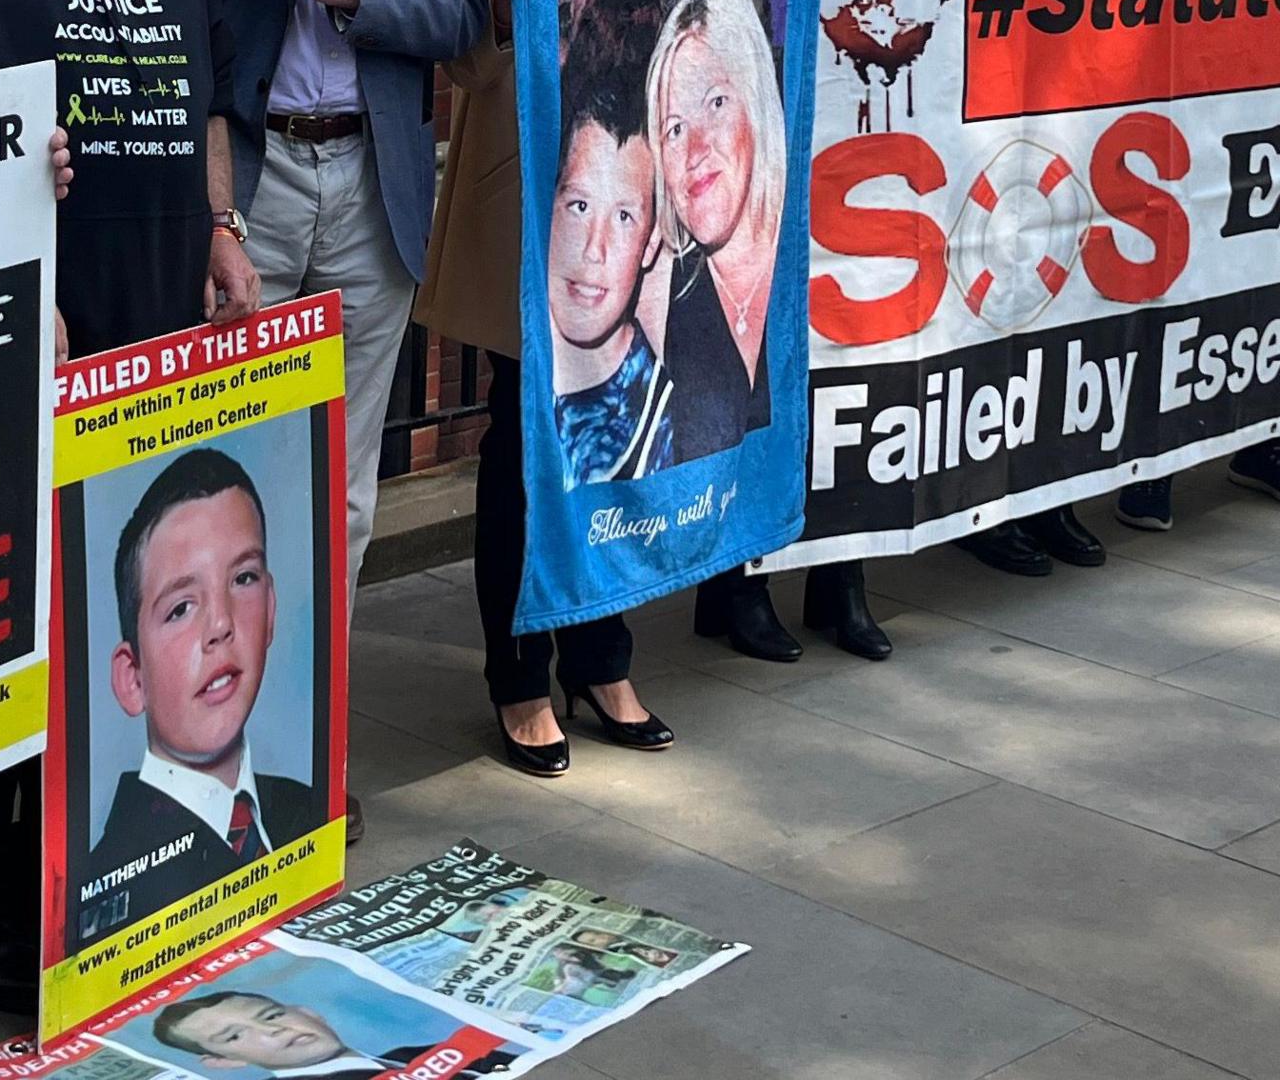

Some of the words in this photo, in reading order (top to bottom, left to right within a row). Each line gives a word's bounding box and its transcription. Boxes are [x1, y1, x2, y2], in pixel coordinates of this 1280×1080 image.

[82, 77, 132, 95] LIVES
[131, 108, 187, 126] MATTER
[81, 141, 119, 156] MINE,
[124, 142, 166, 156] YOURS,
[168, 142, 194, 154] OURS
[54, 355, 150, 408] FAILED
[161, 343, 193, 376] BY
[202, 328, 248, 363] THE
[258, 306, 325, 347] STATE
[75, 408, 118, 437] Dead
[123, 392, 172, 421] within
[177, 388, 185, 405] 7
[190, 378, 226, 401] days
[230, 369, 245, 389] of
[250, 352, 312, 382] entering
[811, 348, 1044, 492] Failed
[1062, 339, 1138, 452] by
[128, 432, 156, 456] The
[161, 418, 213, 447] Linden
[218, 400, 268, 427] Center
[587, 507, 667, 546] Always
[678, 484, 713, 526] with
[80, 856, 149, 902] MATTHEW
[151, 832, 195, 866] LEAHY
[125, 923, 161, 950] cure
[165, 893, 219, 930] mental
[222, 865, 269, 900] health
[279, 902, 354, 934] Mum
[120, 892, 278, 988] #matthewscampaign
[496, 952, 524, 977] care
